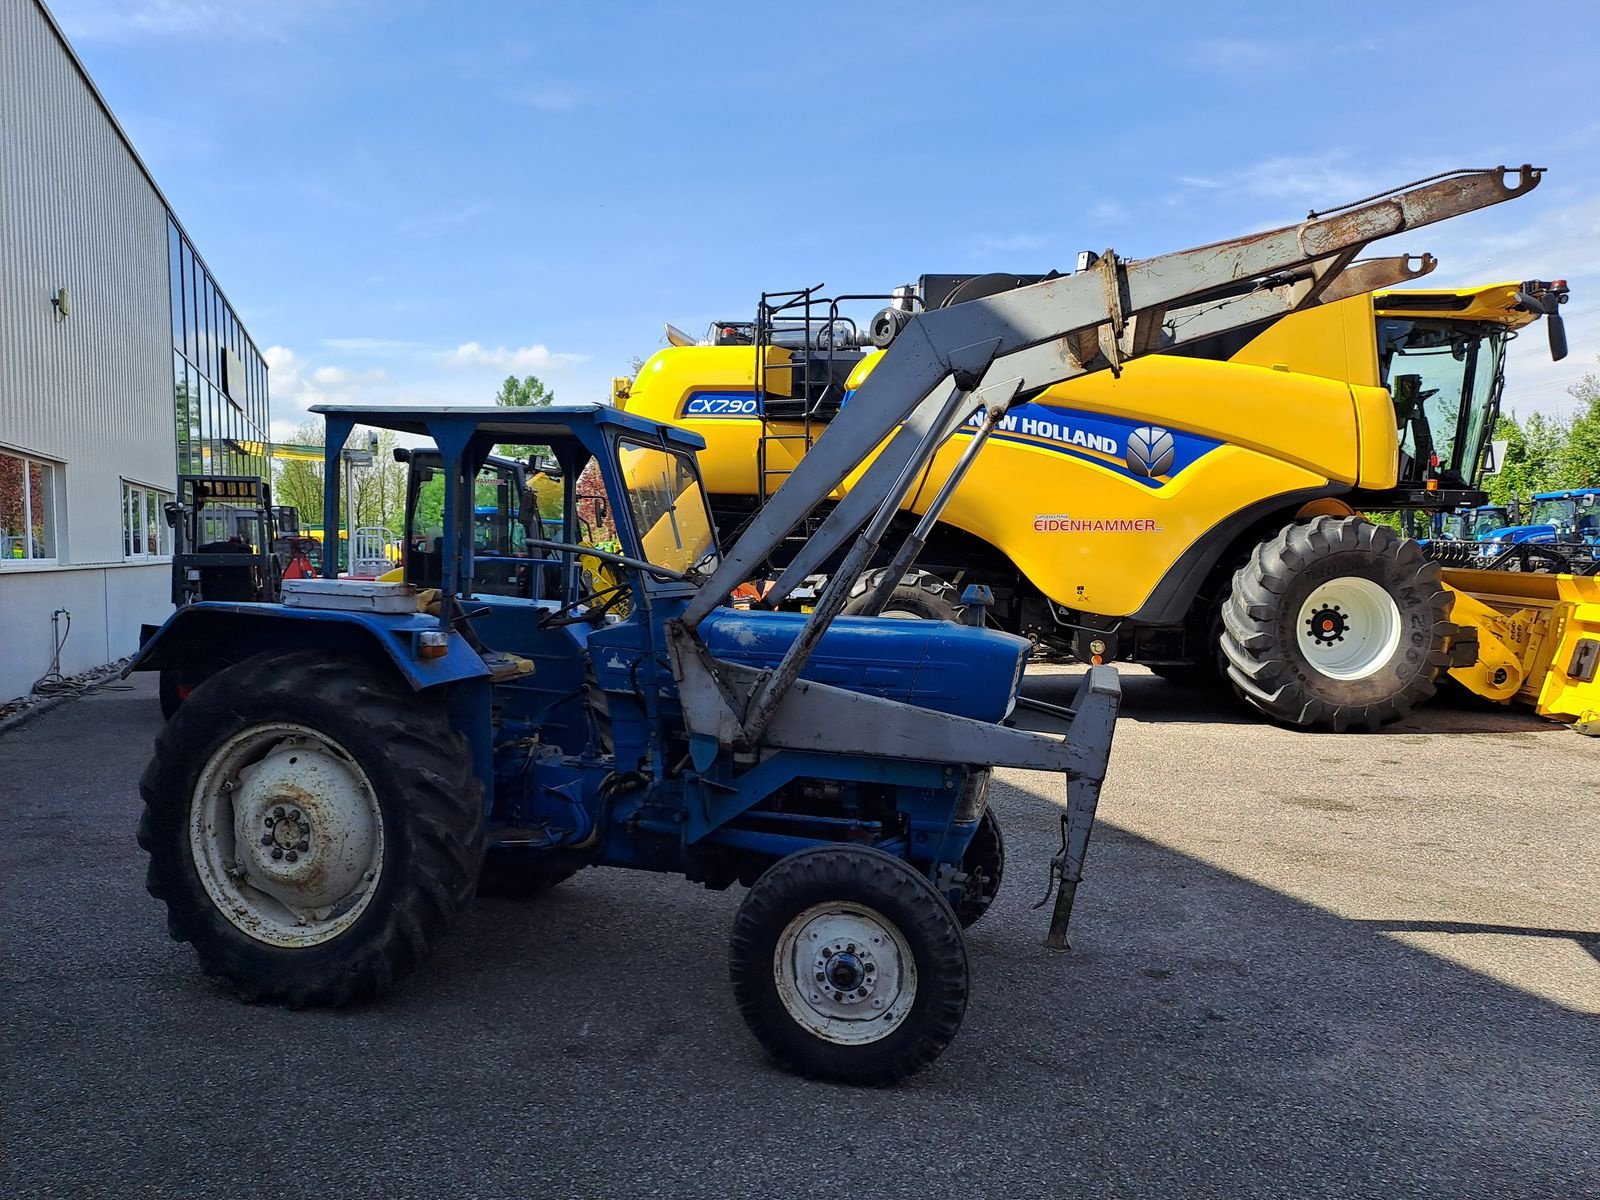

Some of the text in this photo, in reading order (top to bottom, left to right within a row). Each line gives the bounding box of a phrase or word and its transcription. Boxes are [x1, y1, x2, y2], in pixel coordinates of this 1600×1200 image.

[688, 399, 757, 412] CX7.90
[968, 411, 1117, 455] NW HOLLAND
[1034, 519, 1155, 531] EIDENHAMMER
